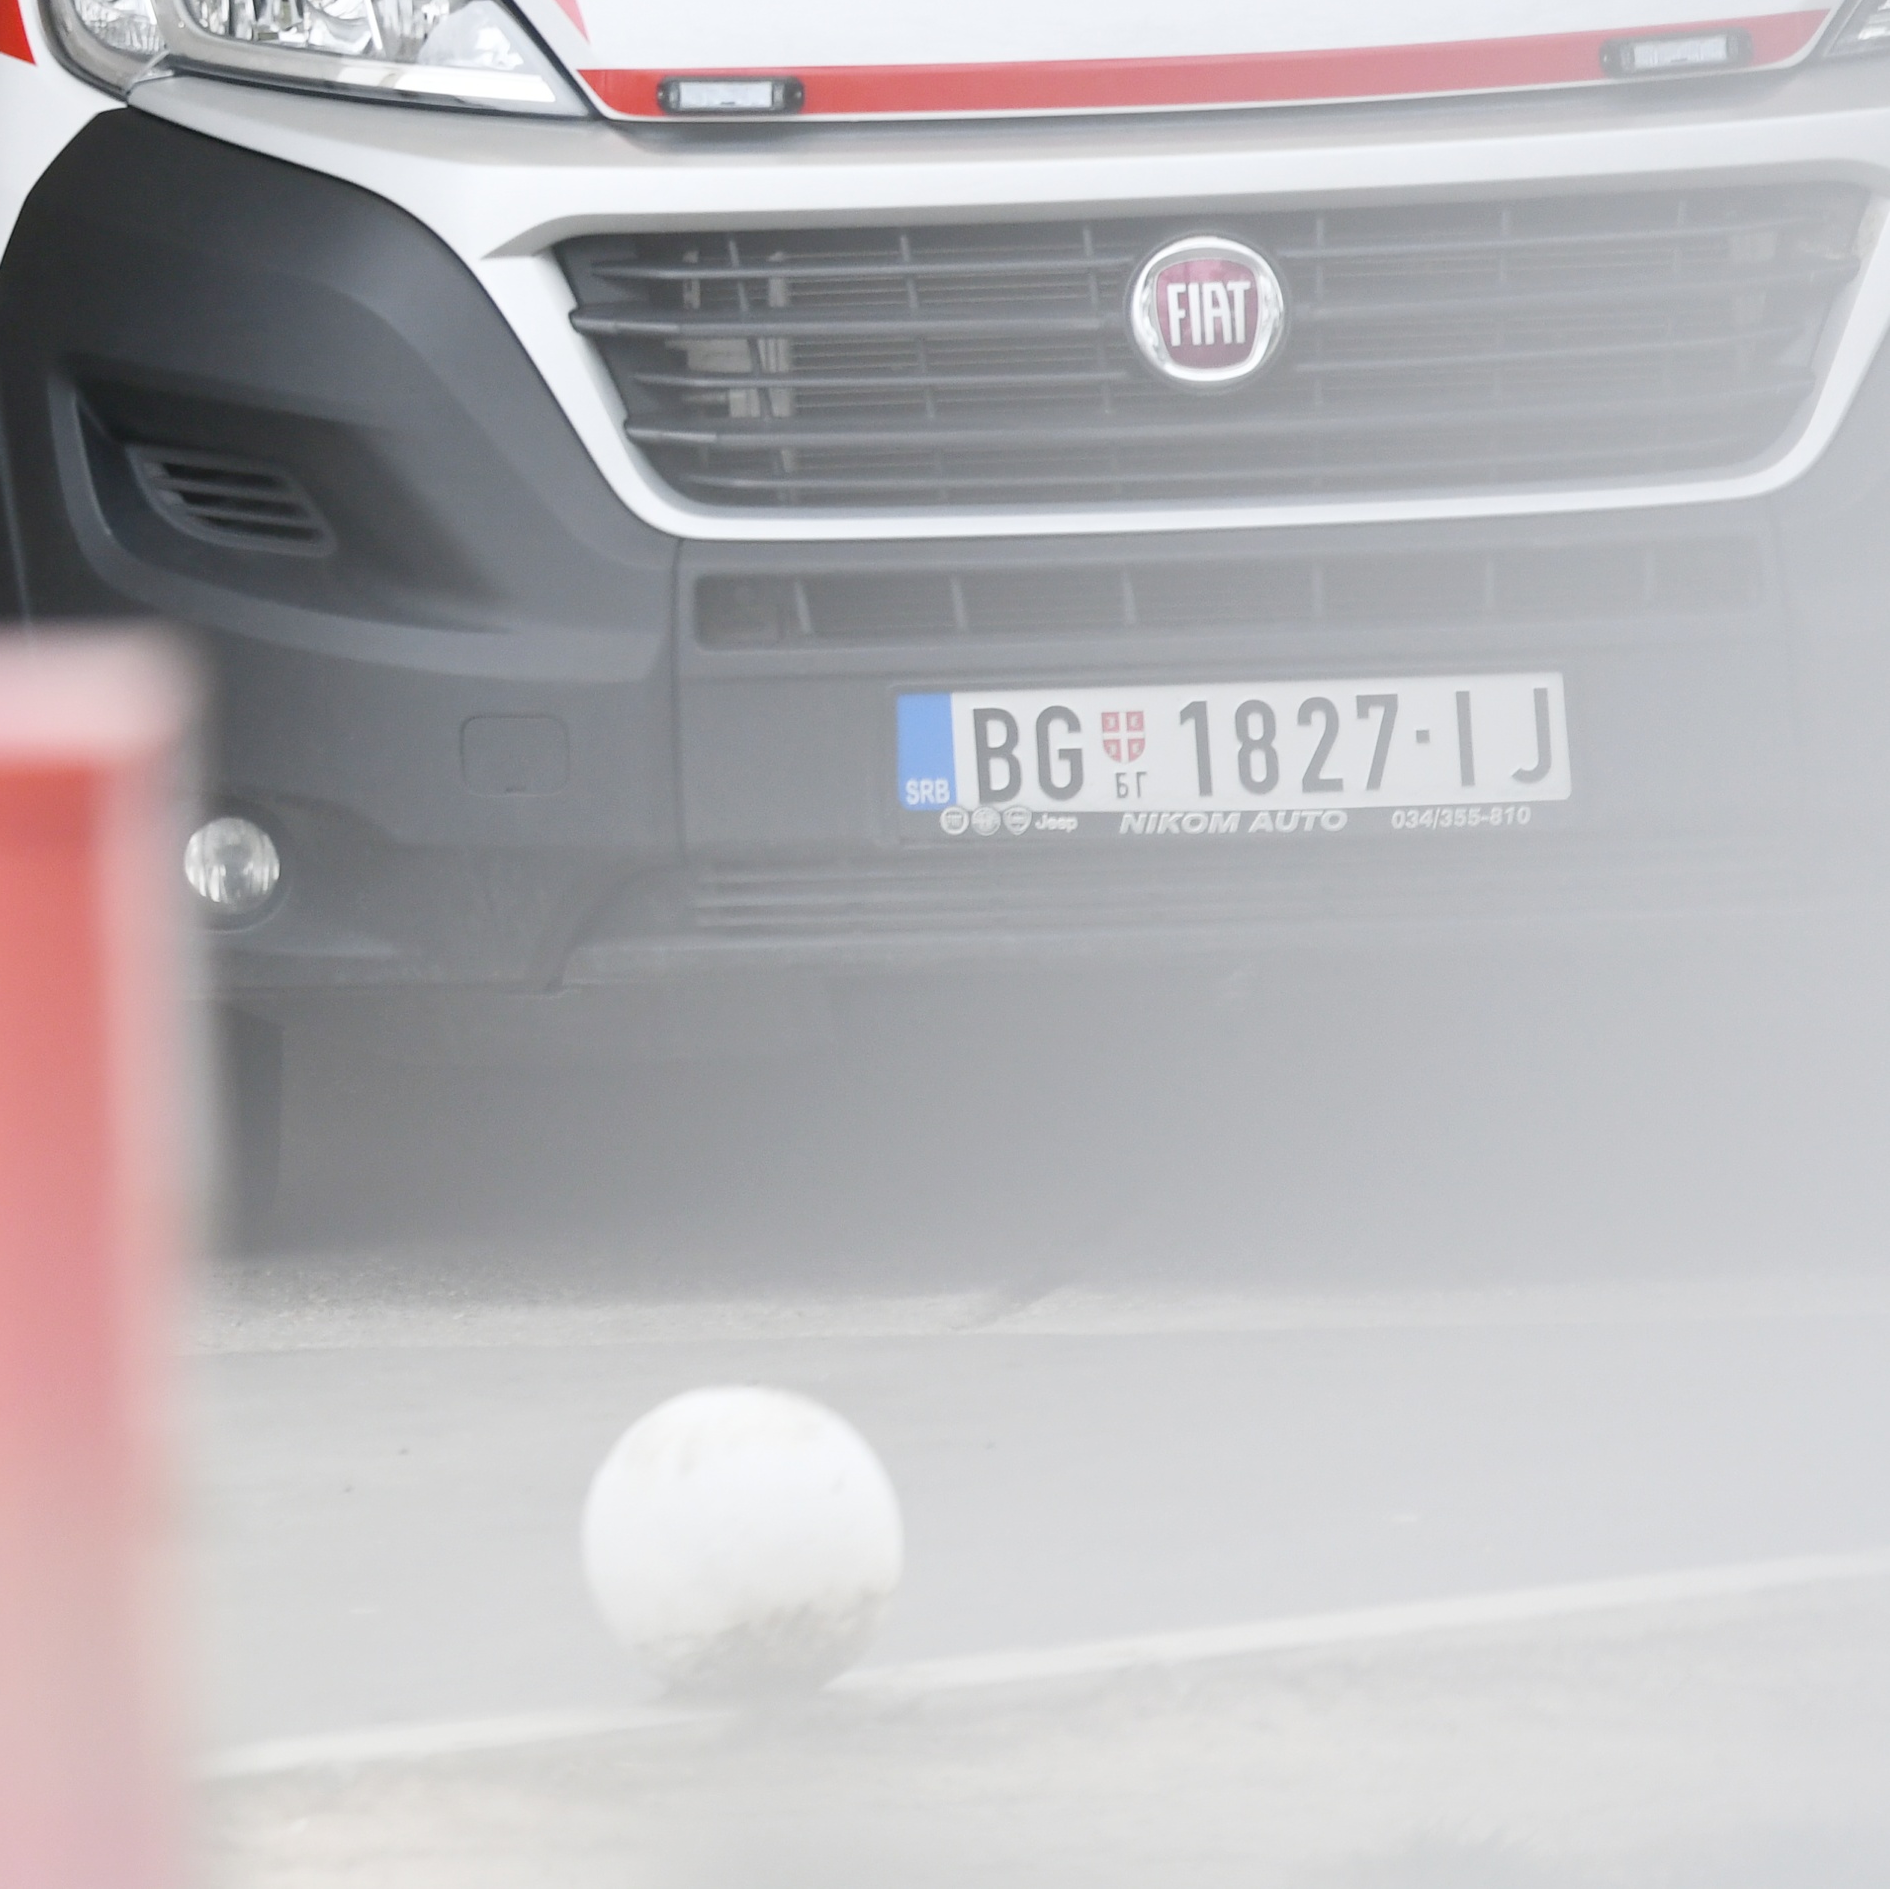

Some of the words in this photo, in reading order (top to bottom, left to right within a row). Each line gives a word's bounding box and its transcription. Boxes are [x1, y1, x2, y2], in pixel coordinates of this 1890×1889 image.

[1167, 281, 1251, 347] FIAT
[973, 705, 1084, 804] BG
[906, 778, 950, 806] SRB
[1119, 812, 1241, 835] NIKOM
[1249, 809, 1348, 833] AUTO
[1391, 806, 1531, 830] 034/355-810
